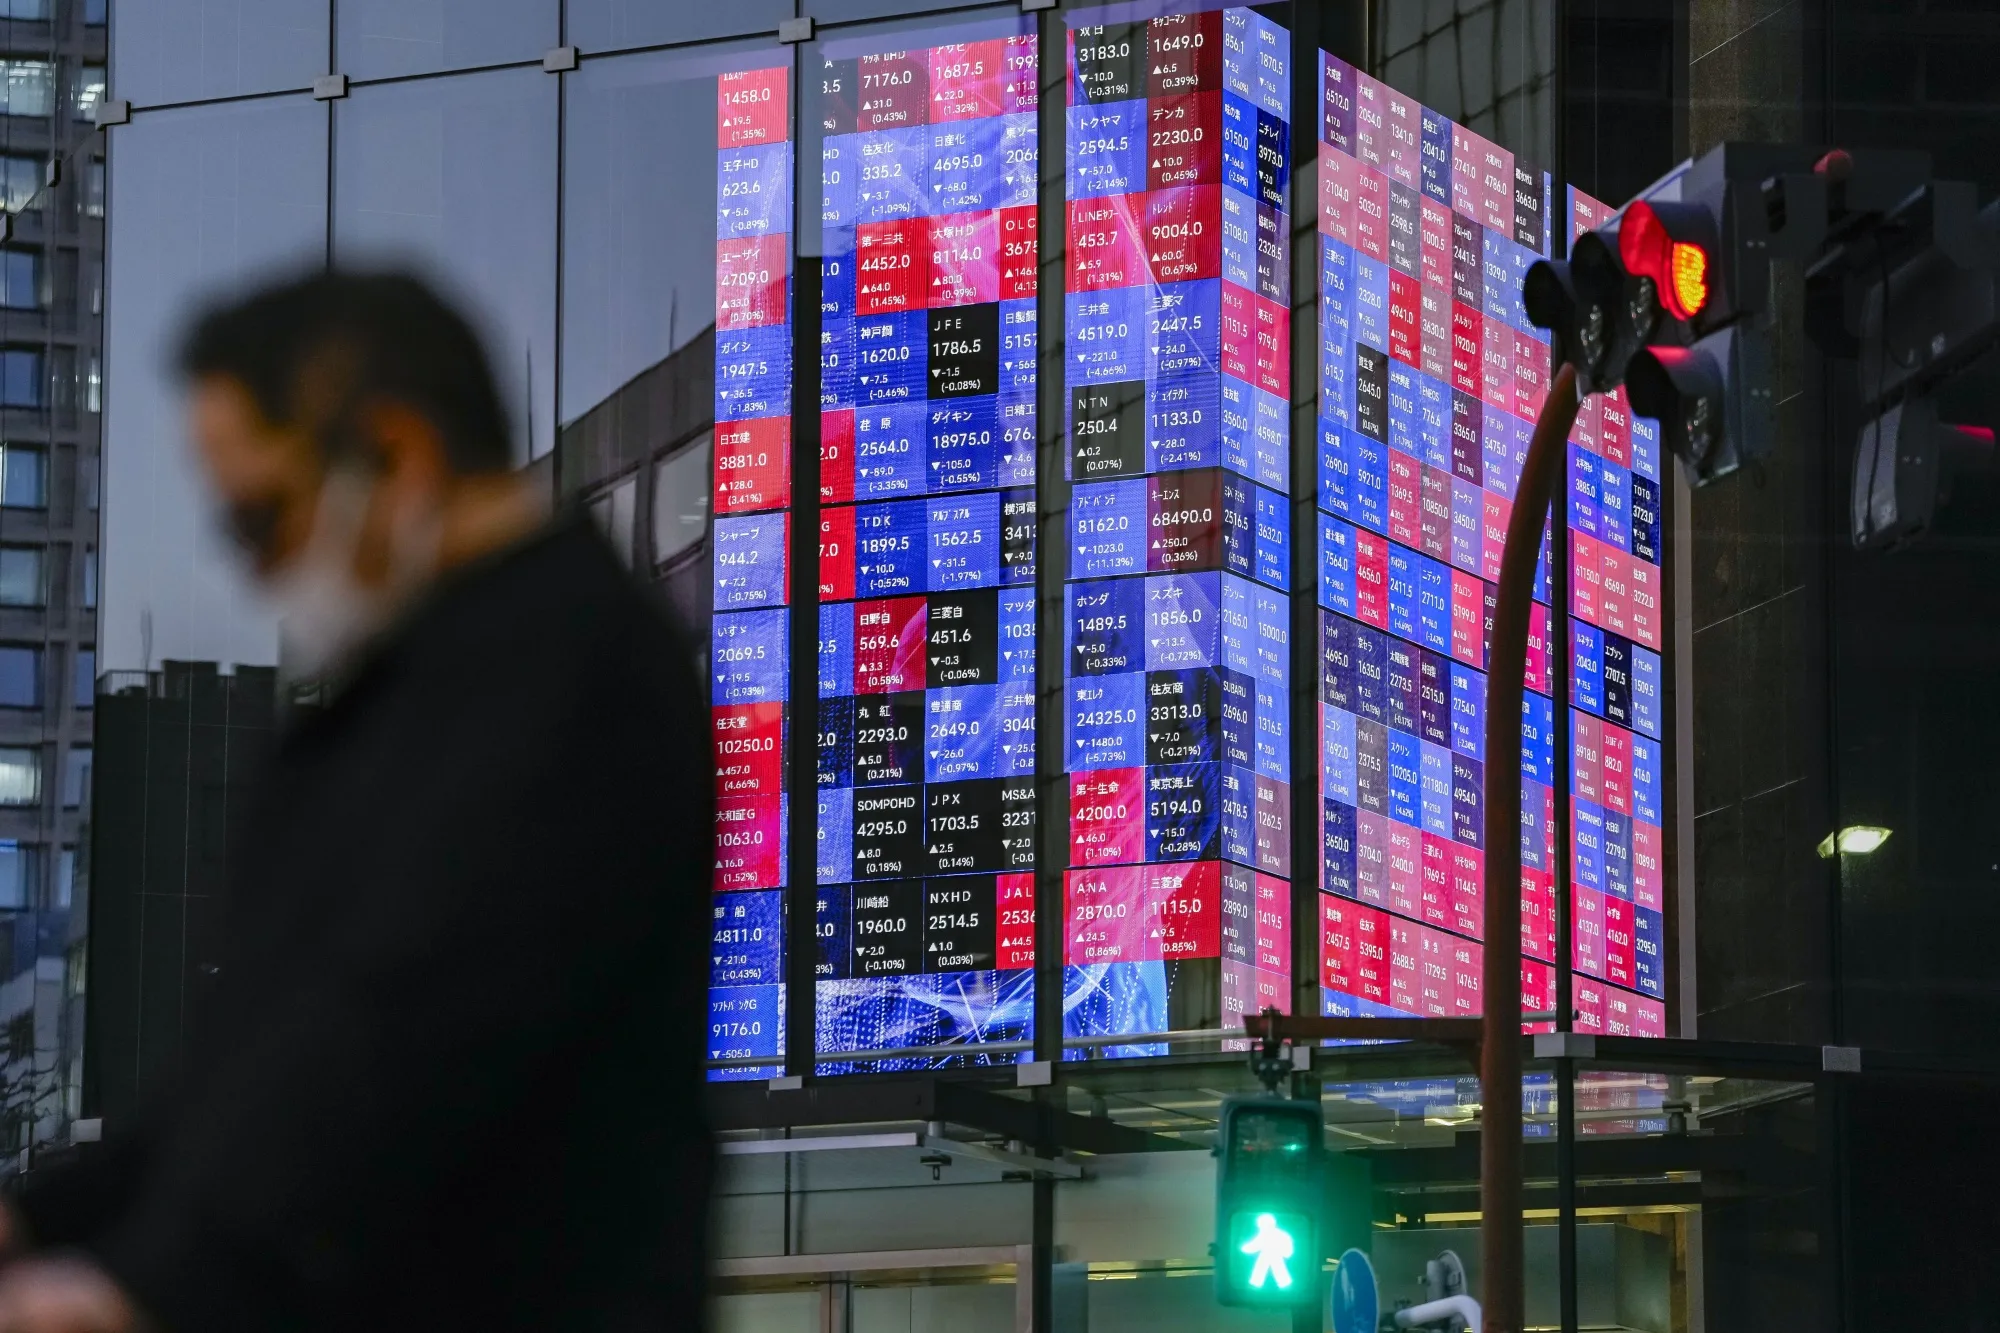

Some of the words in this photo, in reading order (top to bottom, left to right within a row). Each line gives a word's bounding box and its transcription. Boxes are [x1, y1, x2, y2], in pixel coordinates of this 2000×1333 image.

[1154, 34, 1204, 52] 1649.0
[1225, 34, 1245, 54] 856.1
[1079, 43, 1130, 62] 3183.0
[935, 61, 983, 79] 1687.5
[863, 70, 911, 88] 7176.0
[724, 87, 770, 104] 1458.0
[872, 98, 892, 109] 31.0
[1326, 88, 1349, 111] 6512.0
[944, 102, 978, 115] (1.32%)
[1152, 106, 1184, 119] デンカ
[732, 116, 751, 126] 19.5
[872, 111, 907, 124] (0.43%)
[1080, 115, 1121, 129] トクヤマ
[731, 128, 766, 141] (1.35%)
[935, 134, 965, 147] 日産化
[1152, 128, 1203, 146] 2230.0
[863, 143, 894, 156] 住友化
[1079, 137, 1128, 154] 2594.5
[1422, 140, 1445, 163] 2041.0
[722, 158, 758, 172] 王子HD
[934, 154, 982, 172] 4695.0
[862, 164, 901, 181] 335.2
[1162, 169, 1198, 182] (0.45%)
[722, 181, 761, 197] 623.6
[871, 191, 890, 201] -3.7
[942, 194, 982, 208] (-1.42%)
[1515, 190, 1537, 211] 3663.0
[731, 207, 749, 217] -5.6
[871, 202, 910, 216] (-1.09%)
[730, 219, 769, 233] (-0.89%)
[1152, 222, 1203, 239] 9004.0
[1391, 213, 1413, 235] 2598.5
[861, 233, 904, 248] 第一三共
[1079, 231, 1118, 248] 453.7
[721, 249, 761, 264] エーザイ
[861, 255, 911, 272] 4452.0
[933, 247, 982, 264] 8114.0
[721, 271, 769, 287] 4709.0
[870, 282, 891, 293] 64.0
[942, 287, 977, 300] (0.99%)
[870, 295, 905, 308] (1.45%)
[1152, 296, 1184, 309] 三菱マ
[730, 311, 764, 323] (0.70%)
[1078, 304, 1110, 316] 三井金
[1390, 304, 1413, 324] 4941.0
[1152, 316, 1201, 334] 2447.5
[1224, 316, 1248, 337] 1151.5
[1454, 313, 1472, 329] メルカリ
[861, 325, 893, 339] 神戸鋼
[1078, 324, 1128, 341] 4519.0
[721, 341, 751, 354] ガイシ
[933, 339, 981, 356] 1786.5
[1258, 332, 1278, 351] 979.0
[862, 346, 910, 364] 1620.0
[721, 361, 767, 379] 1947.5
[941, 367, 960, 378] -1.5
[869, 374, 888, 384] -7.5
[941, 379, 981, 393] (-0.08%)
[869, 385, 909, 399] (-0.46%)
[1358, 379, 1381, 399] 2645.0
[729, 400, 767, 414] (-1.83%)
[932, 411, 973, 424] ダイキン
[1152, 411, 1202, 427] 1133.0
[1078, 419, 1118, 435] 250.4
[720, 432, 751, 445] 日立建
[933, 430, 990, 449] 18975.0
[860, 438, 909, 456] 2564.0
[719, 452, 767, 470] 3881.0
[729, 480, 753, 490] 128.0
[869, 478, 908, 492] (-3.35%)
[941, 471, 981, 486] (-0.55%)
[1358, 469, 1381, 490] 5921.0
[728, 492, 762, 505] (3.41%)
[1633, 484, 1650, 500] TOTO
[1152, 509, 1212, 527] 68490.0
[1633, 505, 1654, 524] 3723.0
[1078, 516, 1128, 533] 8162.0
[719, 527, 760, 542] シャープ
[934, 529, 982, 547] 1562.5
[1258, 523, 1282, 544] 3632.0
[862, 536, 909, 554] 1899.5
[719, 550, 758, 565] 944.2
[1162, 550, 1198, 563] (0.36%)
[1358, 565, 1381, 584] 4656.0
[1077, 593, 1109, 607] ホンダ
[1152, 587, 1184, 600] スズキ
[1422, 591, 1445, 610] 2711.0
[860, 613, 891, 626] 日野自
[931, 606, 963, 620] 三菱自
[1152, 610, 1202, 625] 1856.0
[1078, 615, 1127, 632] 1489.5
[859, 634, 900, 651] 569.6
[931, 627, 972, 645] 451.6
[717, 645, 765, 663] 2069.5
[868, 674, 904, 687] (0.58%)
[940, 667, 980, 681] (-0.06%)
[1151, 682, 1184, 695] 住友商
[1223, 680, 1246, 697] SUBARU
[931, 699, 962, 712] 豊通商
[1151, 704, 1201, 721] 3313.0
[1453, 698, 1476, 716] 2754.0
[716, 716, 747, 730] 任天堂
[1076, 710, 1136, 727] 24325.0
[859, 726, 908, 743] 2293.0
[931, 721, 980, 738] 2649.0
[717, 737, 774, 754] 10250.0
[725, 765, 751, 775] 457.0
[867, 767, 902, 779] (0.21%)
[1634, 767, 1651, 784] 416.0
[724, 778, 760, 791] (4.66%)
[1076, 782, 1119, 795] 第一生命
[1150, 778, 1194, 791] 東京海上
[1454, 787, 1476, 805] 4954.0
[857, 797, 915, 812] SOMPOHD
[1151, 800, 1201, 816] 5194.0
[716, 807, 756, 822] 大和証G
[1076, 805, 1126, 821] 4200.0
[1258, 811, 1282, 831] 1262.5
[857, 820, 907, 837] 4295.0
[931, 814, 979, 832] 1703.5
[716, 830, 763, 847] 1063.0
[1326, 833, 1349, 852] 3650.0
[866, 860, 902, 873] (0.18%)
[938, 855, 974, 868] (0.14%)
[724, 870, 758, 883] (1.52%)
[1151, 877, 1183, 889] 三菱倉
[1455, 877, 1477, 896] 1144.5
[856, 895, 888, 908] 川崎船
[1152, 900, 1201, 916] 1115.0
[1223, 900, 1248, 919] 2899.0
[1076, 904, 1126, 920] 2870.0
[1258, 910, 1282, 929] 1419.5
[857, 916, 906, 934] 1960.0
[929, 913, 979, 930] 2514.5
[714, 926, 762, 944] 4811.0
[1607, 929, 1628, 947] 4162.0
[1360, 942, 1383, 961] 5395.0
[865, 957, 905, 970] (-0.10%)
[712, 1020, 761, 1037] 9176.0
